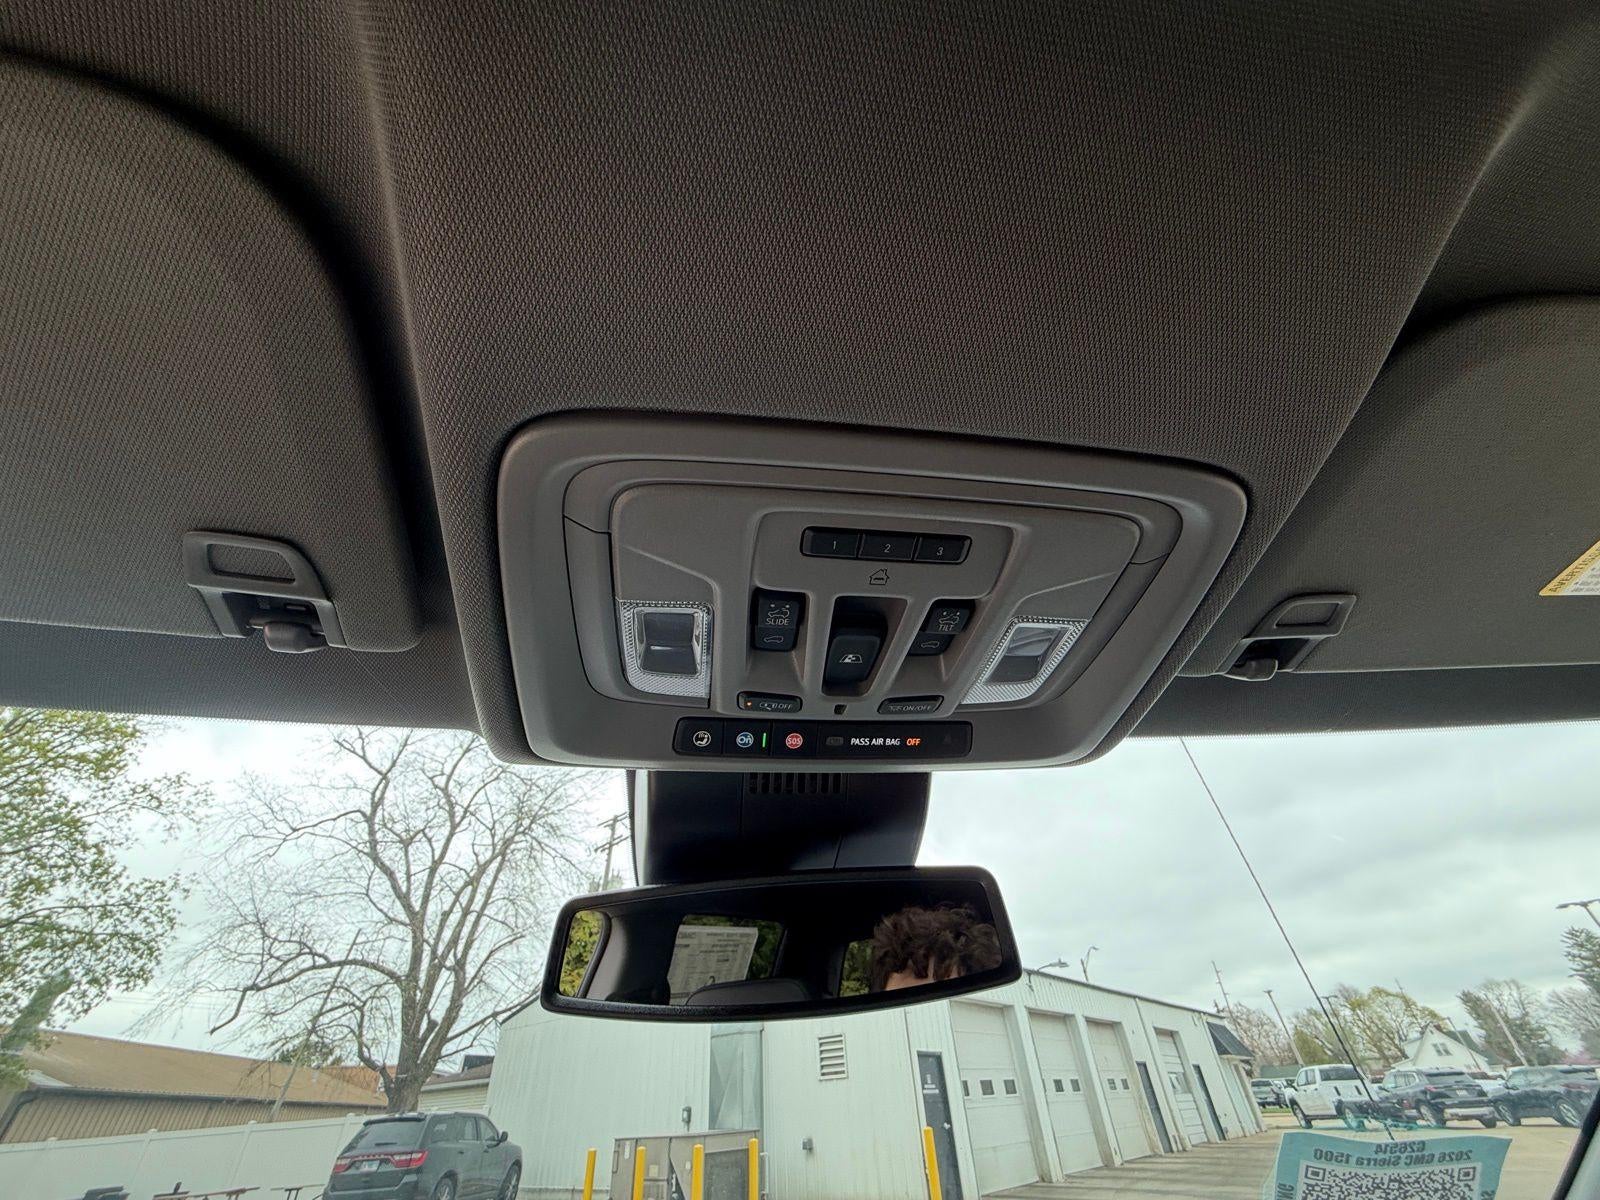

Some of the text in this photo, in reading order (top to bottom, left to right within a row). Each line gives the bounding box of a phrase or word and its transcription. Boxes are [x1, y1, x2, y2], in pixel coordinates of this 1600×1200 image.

[883, 543, 891, 553] 2
[936, 546, 944, 556] 3
[766, 617, 790, 626] SLIDE
[938, 624, 954, 632] TILT
[787, 737, 801, 745] SOS
[850, 737, 921, 746] PASS AIR BAG OFF
